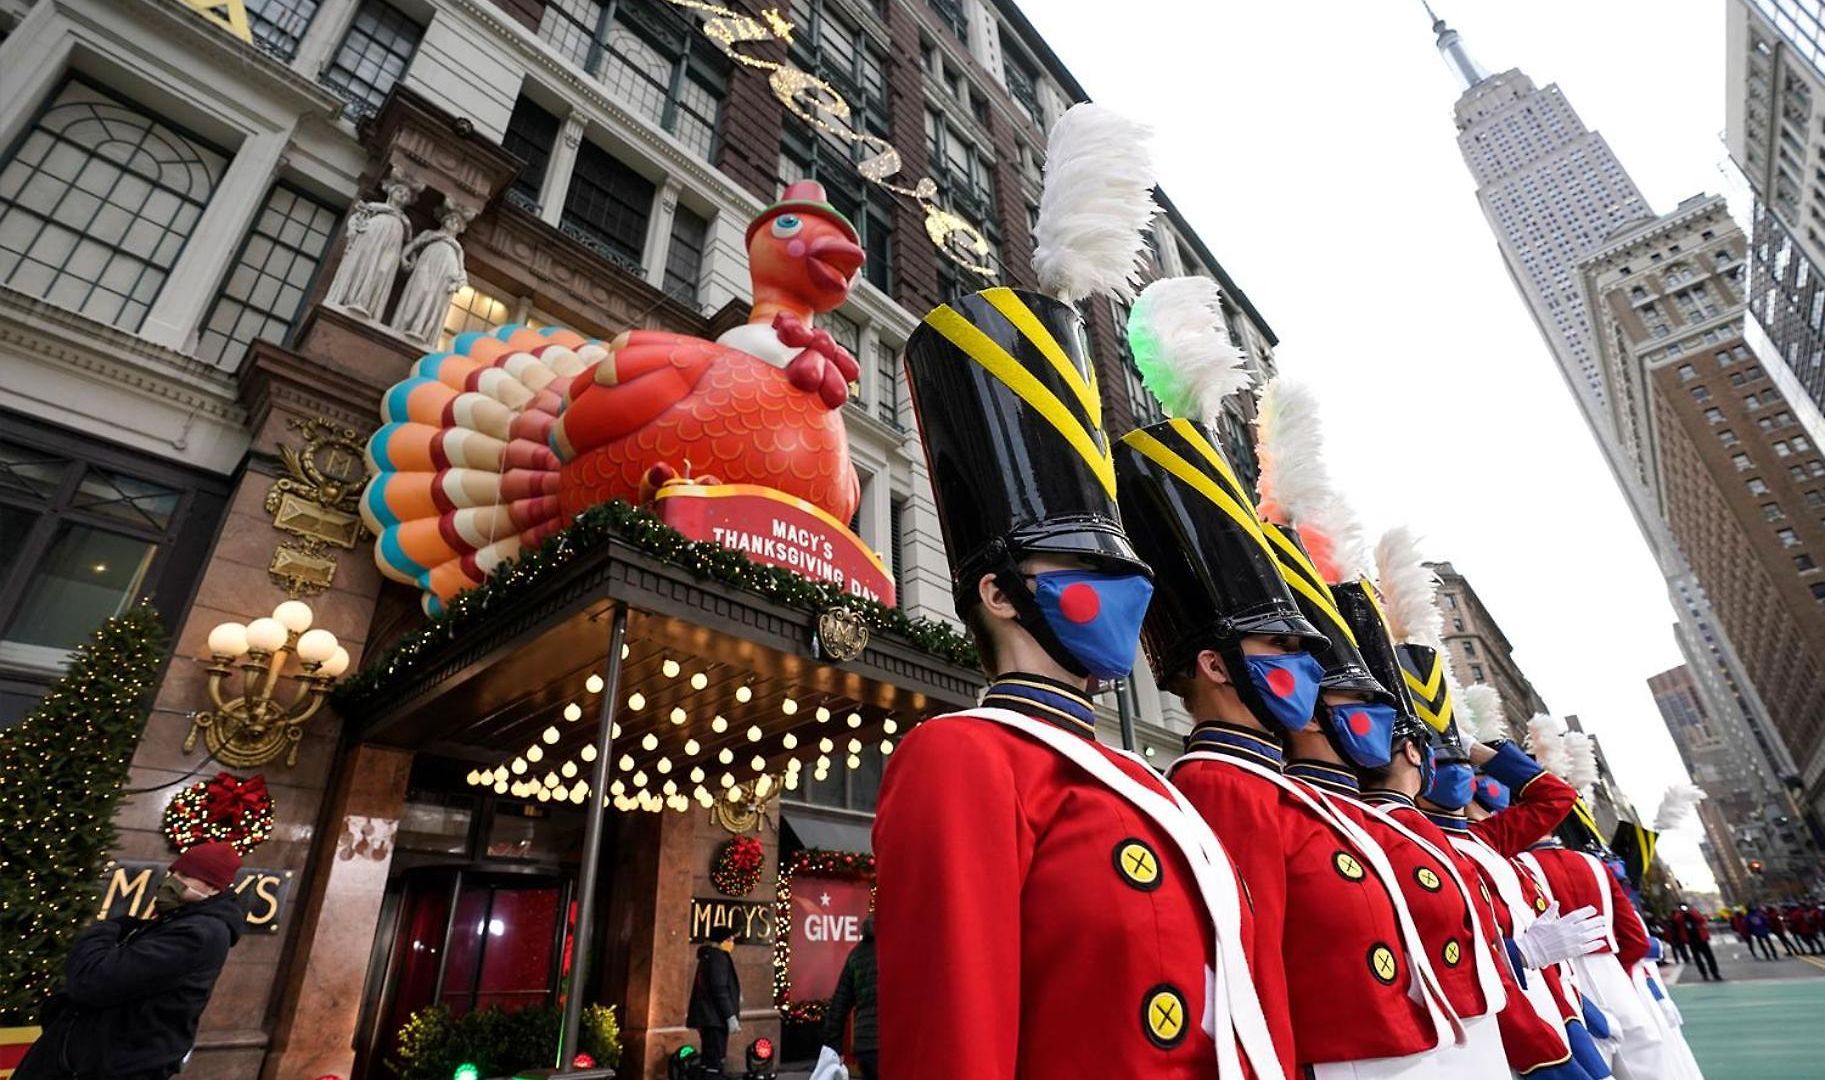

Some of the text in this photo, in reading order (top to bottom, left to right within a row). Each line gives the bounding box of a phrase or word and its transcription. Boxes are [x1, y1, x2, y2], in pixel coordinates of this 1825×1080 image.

[773, 519, 833, 560] MACY'S
[713, 528, 844, 584] THANKSGIVING
[851, 578, 880, 603] DAY
[97, 868, 280, 924] M'S
[804, 914, 863, 942] GIVE.
